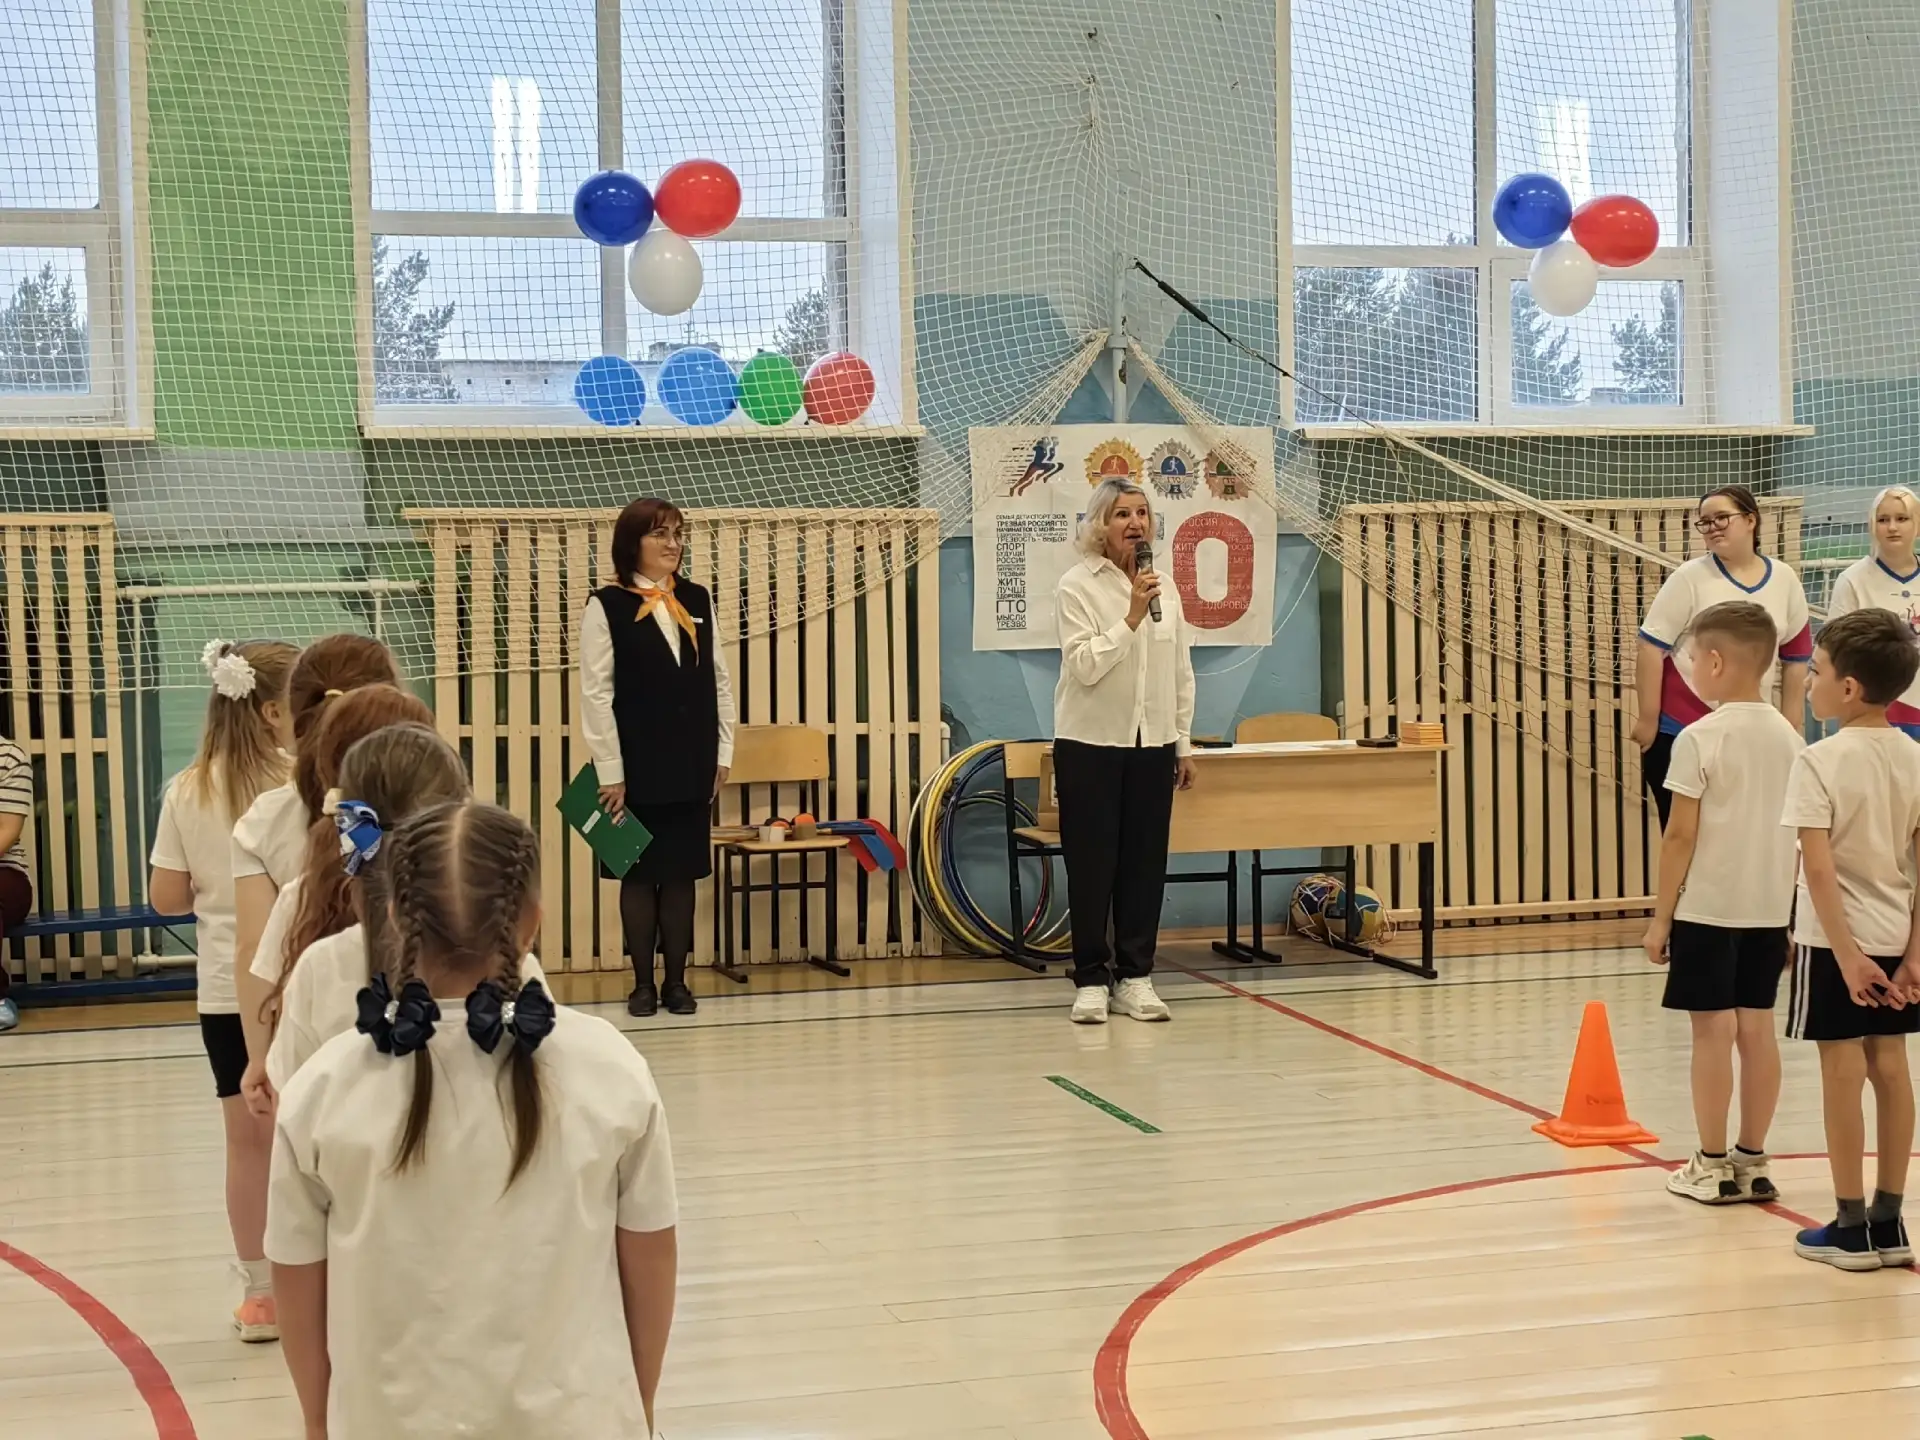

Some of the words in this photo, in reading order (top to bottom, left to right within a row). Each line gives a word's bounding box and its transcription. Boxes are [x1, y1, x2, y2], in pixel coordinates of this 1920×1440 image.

[997, 578, 1026, 586] ЖИТЬ
[997, 586, 1026, 594] ЛУЧШЕ
[996, 600, 1026, 613] ГТО
